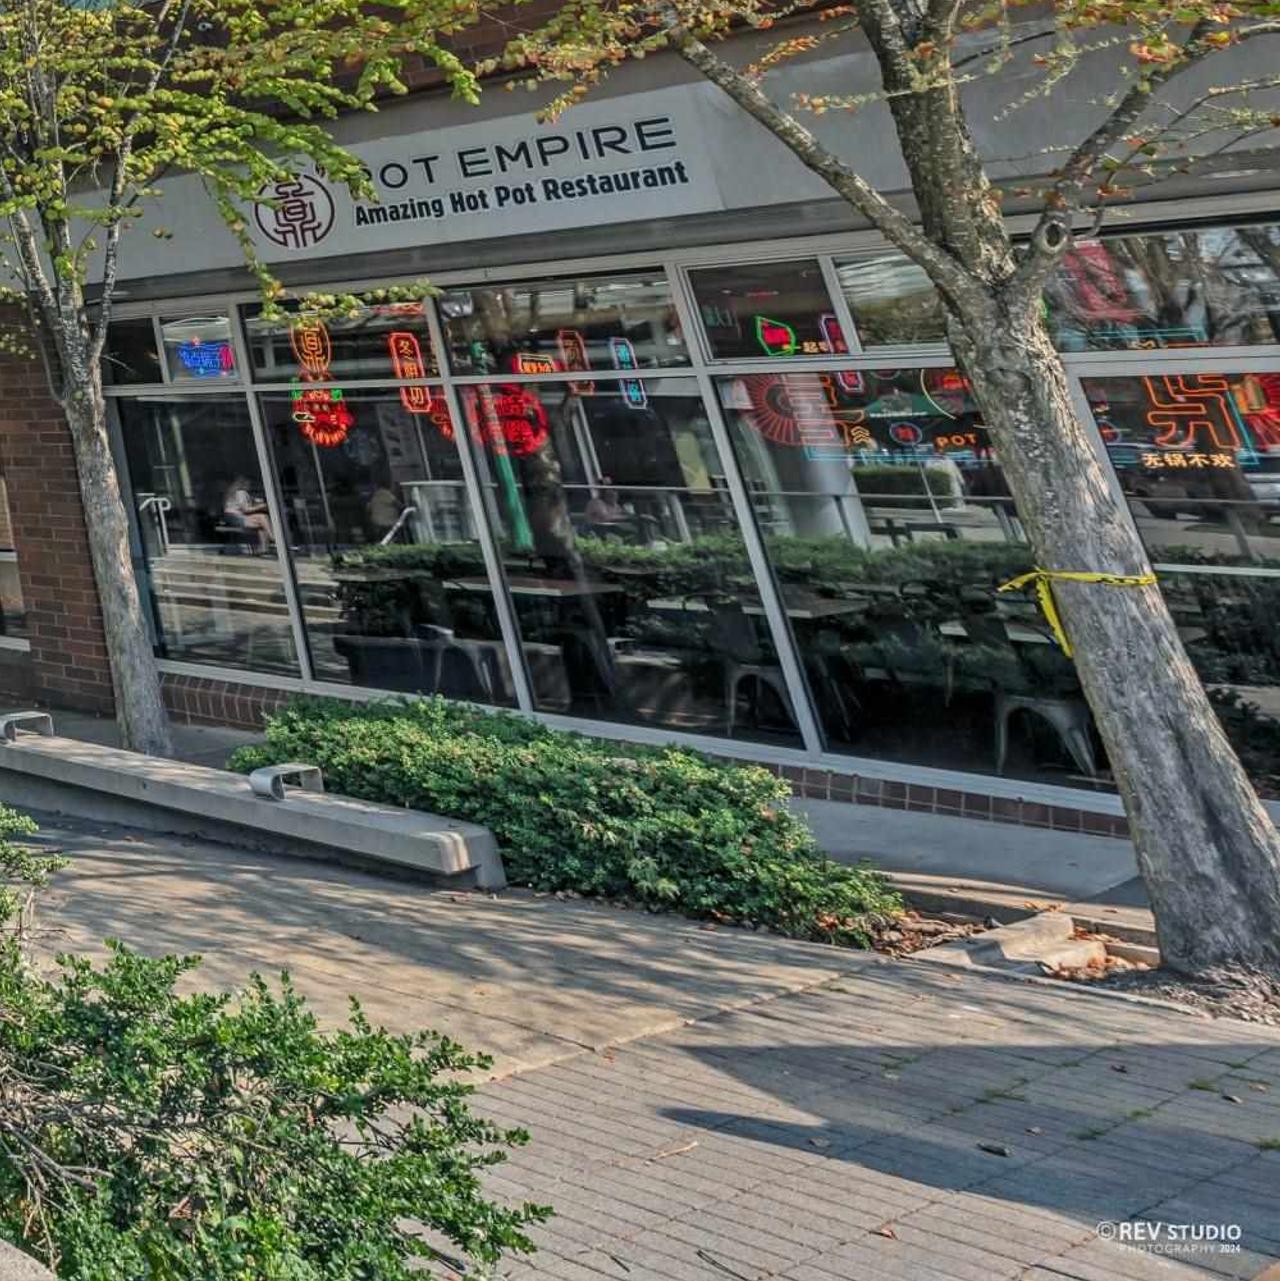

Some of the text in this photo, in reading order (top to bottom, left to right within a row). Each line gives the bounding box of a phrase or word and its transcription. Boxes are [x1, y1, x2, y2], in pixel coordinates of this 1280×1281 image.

[457, 117, 677, 178] EMPIRE
[355, 160, 689, 226] Amazing Hot Pot Restaurant
[934, 432, 977, 450] POT
